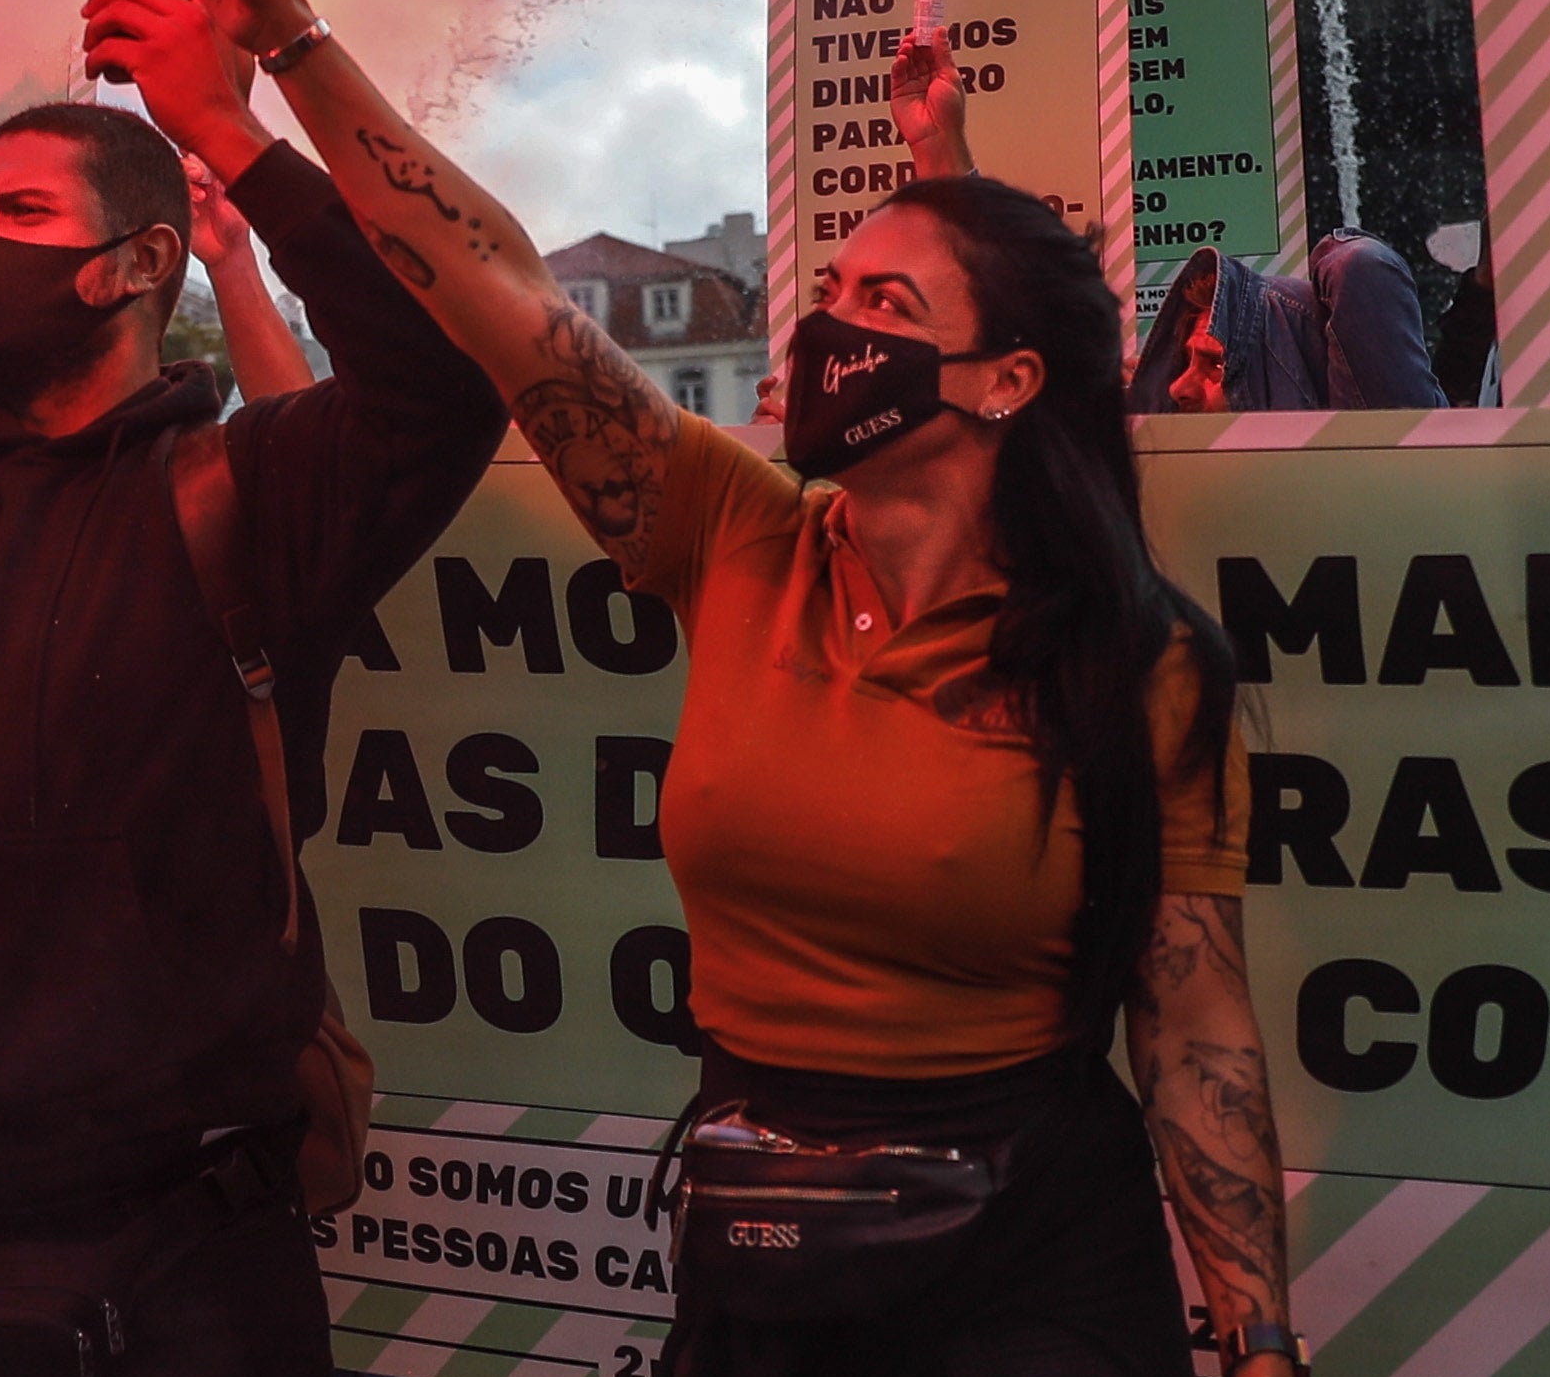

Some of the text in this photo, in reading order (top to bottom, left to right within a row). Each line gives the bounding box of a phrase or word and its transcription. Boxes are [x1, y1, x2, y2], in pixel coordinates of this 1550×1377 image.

[1129, 58, 1186, 82] SEM
[812, 161, 917, 197] CORD
[1131, 152, 1263, 182] AMENTO.
[844, 407, 903, 446] GUESS
[434, 557, 679, 677] MO
[336, 729, 545, 855] AS
[359, 906, 563, 1035] DO
[407, 1156, 590, 1214] SOMOS
[352, 1214, 580, 1283] PESSOAS
[594, 1245, 676, 1295] CA
[727, 1221, 800, 1248] GUESS
